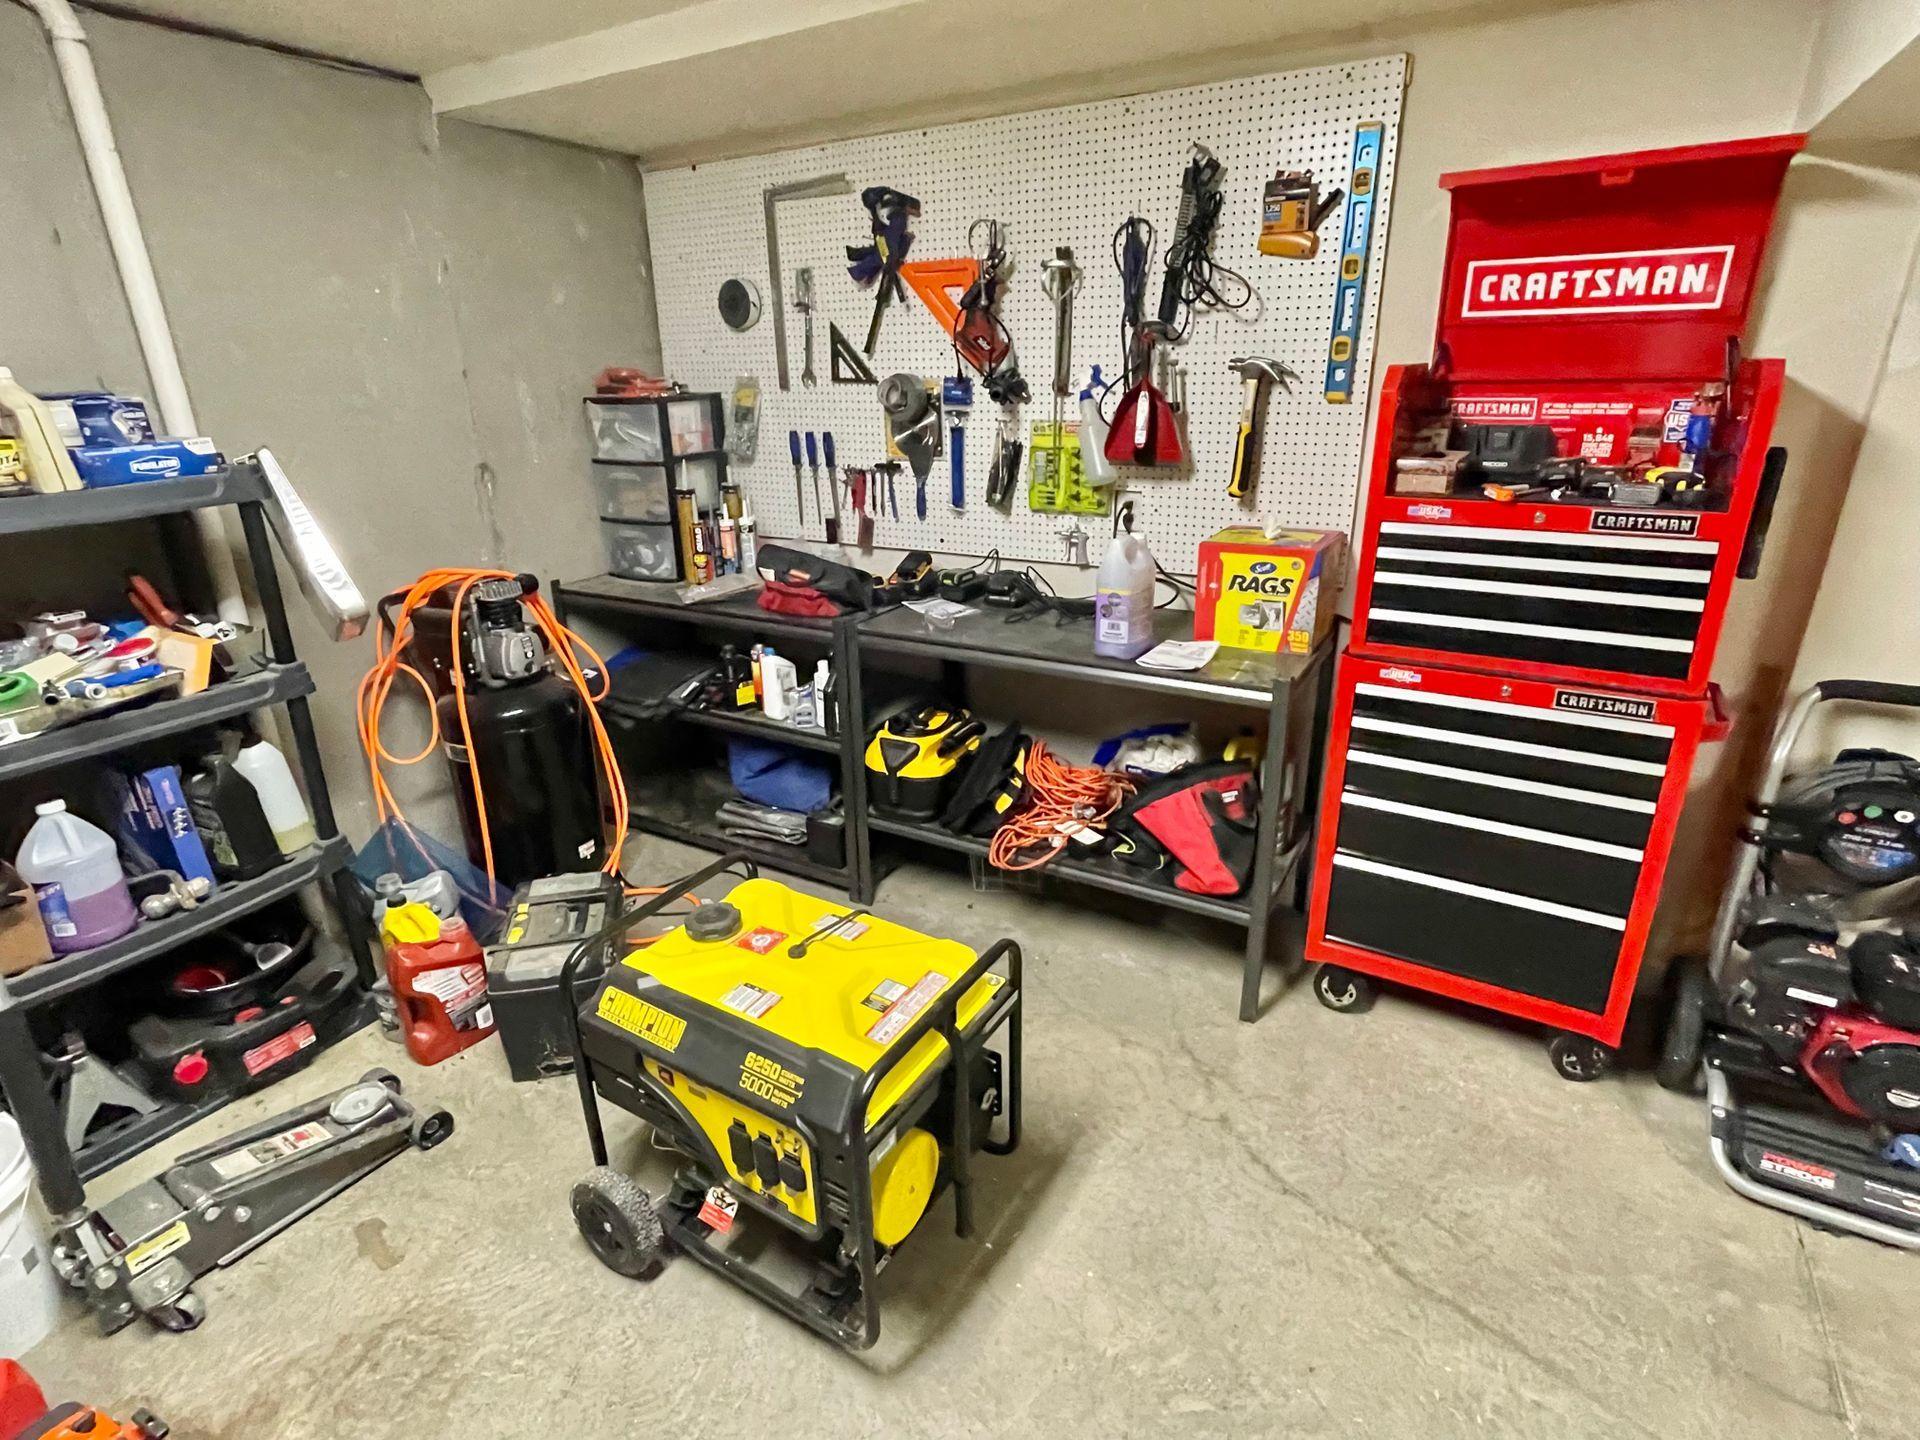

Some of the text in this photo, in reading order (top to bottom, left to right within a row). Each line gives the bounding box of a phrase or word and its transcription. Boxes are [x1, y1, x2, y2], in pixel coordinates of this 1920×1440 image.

[1479, 263, 1710, 303] CRAFTSMAN
[1451, 402, 1531, 415] CRAFTSMAN
[1597, 514, 1692, 531] CRAFTSMAN
[1228, 574, 1295, 595] RAGS
[1560, 694, 1650, 717] CRAFTSMAN
[600, 988, 686, 1045] CHAMPION
[744, 1051, 782, 1080] 6250
[739, 1071, 774, 1100] 5000
